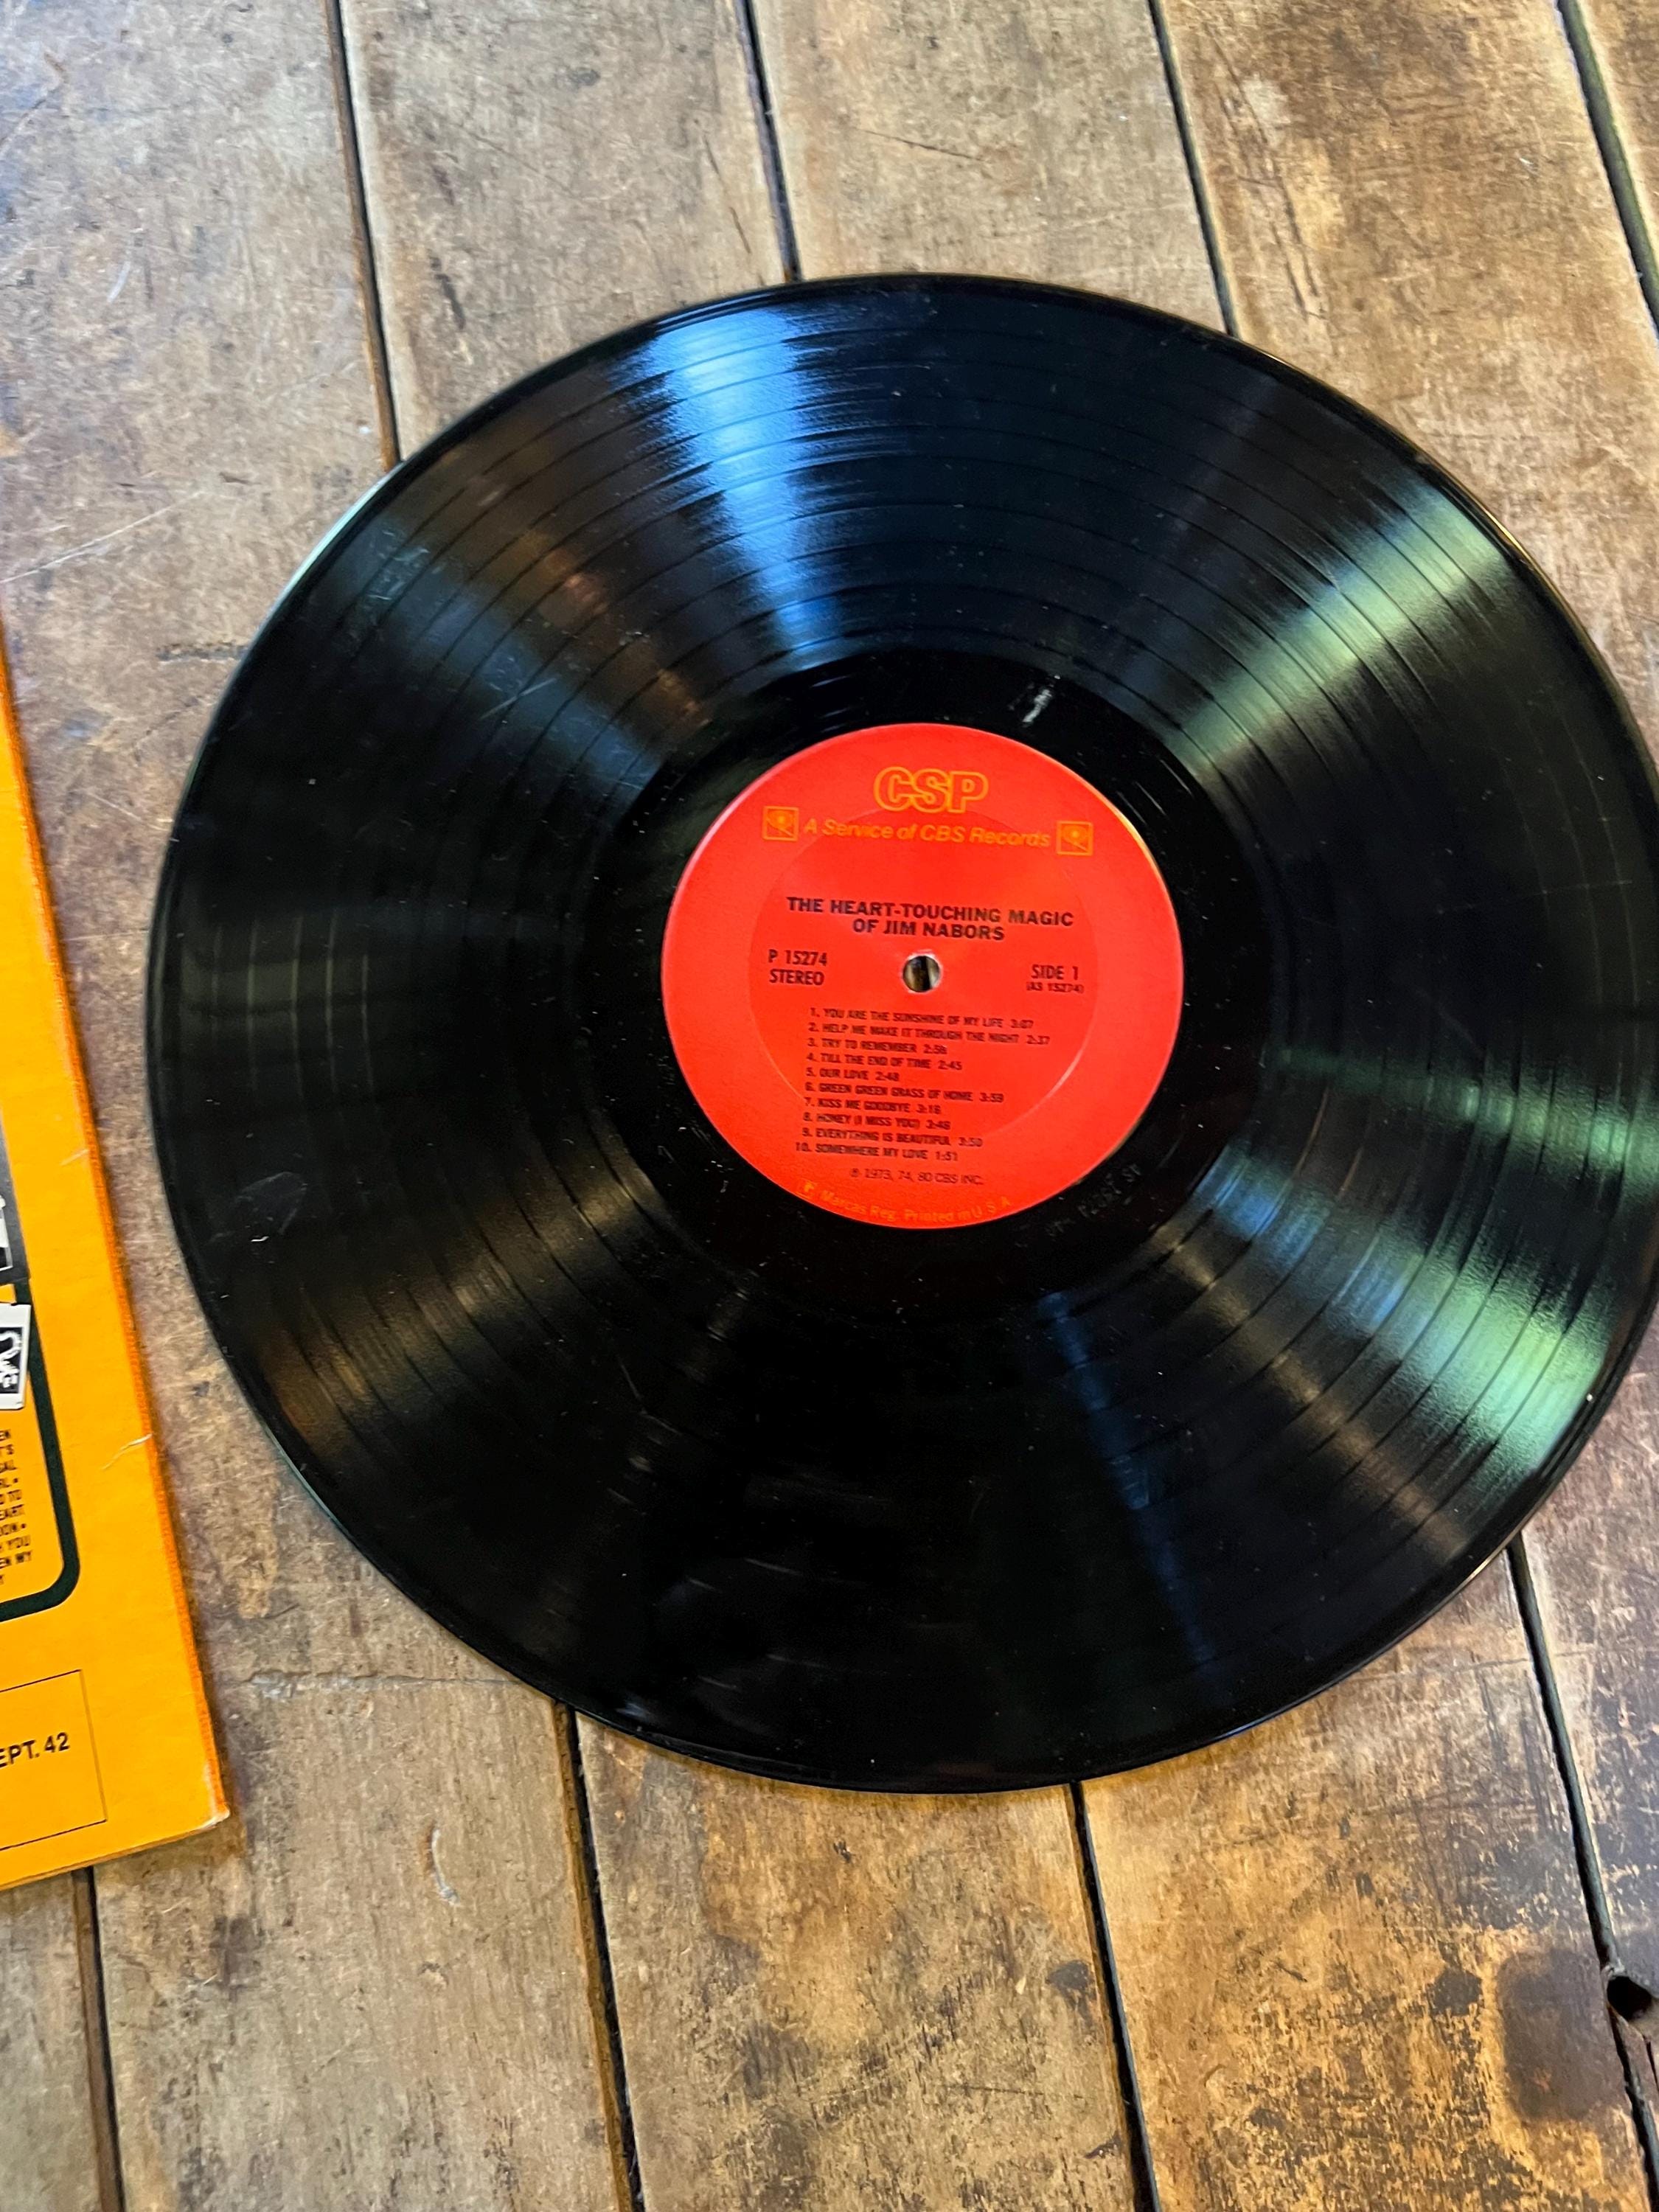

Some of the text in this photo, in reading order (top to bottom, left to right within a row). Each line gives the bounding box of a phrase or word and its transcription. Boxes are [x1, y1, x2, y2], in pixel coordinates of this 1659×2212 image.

[873, 766, 990, 813] CSP
[804, 818, 1051, 847] A Service of CBS Records
[786, 896, 1074, 927] THE HEART-TOUCHING MAGIC
[853, 918, 1005, 941] OF JIM NABORS
[768, 948, 828, 966] P 15274
[769, 968, 825, 986] STEREO
[1031, 964, 1079, 981] SIDE 1
[823, 1008, 844, 1018] YOU
[847, 1009, 867, 1020] ARE
[870, 1011, 889, 1021] THE
[893, 1012, 945, 1024] SUNSHINE
[947, 1015, 960, 1025] OF
[963, 1017, 979, 1026] MY
[983, 1018, 1004, 1028] LIFE
[822, 1023, 849, 1033] HELP
[851, 1025, 866, 1034] ME
[869, 1026, 898, 1037] MAKE
[901, 1028, 914, 1037] IT
[915, 1029, 961, 1040] THROUGH
[965, 1031, 985, 1042] THE
[988, 1033, 1019, 1043] NIGHT
[821, 1038, 841, 1048] TRY
[845, 1040, 858, 1049] TO
[860, 1040, 917, 1053] REMEMBER
[821, 1053, 841, 1063] TILL
[844, 1054, 864, 1065] THE
[868, 1056, 888, 1065] END
[890, 1057, 904, 1067] OF
[906, 1058, 931, 1068] TIME
[820, 1068, 841, 1078] OUR
[844, 1070, 869, 1080] LOVE
[819, 1083, 852, 1093] GREEN
[855, 1085, 888, 1096] GREEN
[891, 1087, 925, 1098] GRASS
[928, 1089, 941, 1099] OF
[943, 1091, 973, 1102] HOME
[818, 1098, 842, 1108] KISS
[846, 1099, 860, 1110] ME
[863, 1101, 911, 1113] GOODBYE
[817, 1113, 851, 1124] HONEY
[866, 1116, 892, 1126] MISS
[815, 1128, 879, 1141] EVERYTHING
[883, 1133, 893, 1141] IS
[896, 1133, 950, 1145] BEAUTIFUL
[815, 1144, 880, 1156] SOMEWHERE
[883, 1147, 899, 1157] MY
[902, 1149, 928, 1159] LOVE
[935, 1172, 957, 1183] CBS
[904, 1208, 953, 1222] Printed
[8, 1535, 31, 1550] YOU
[44, 1732, 70, 1753] 42
